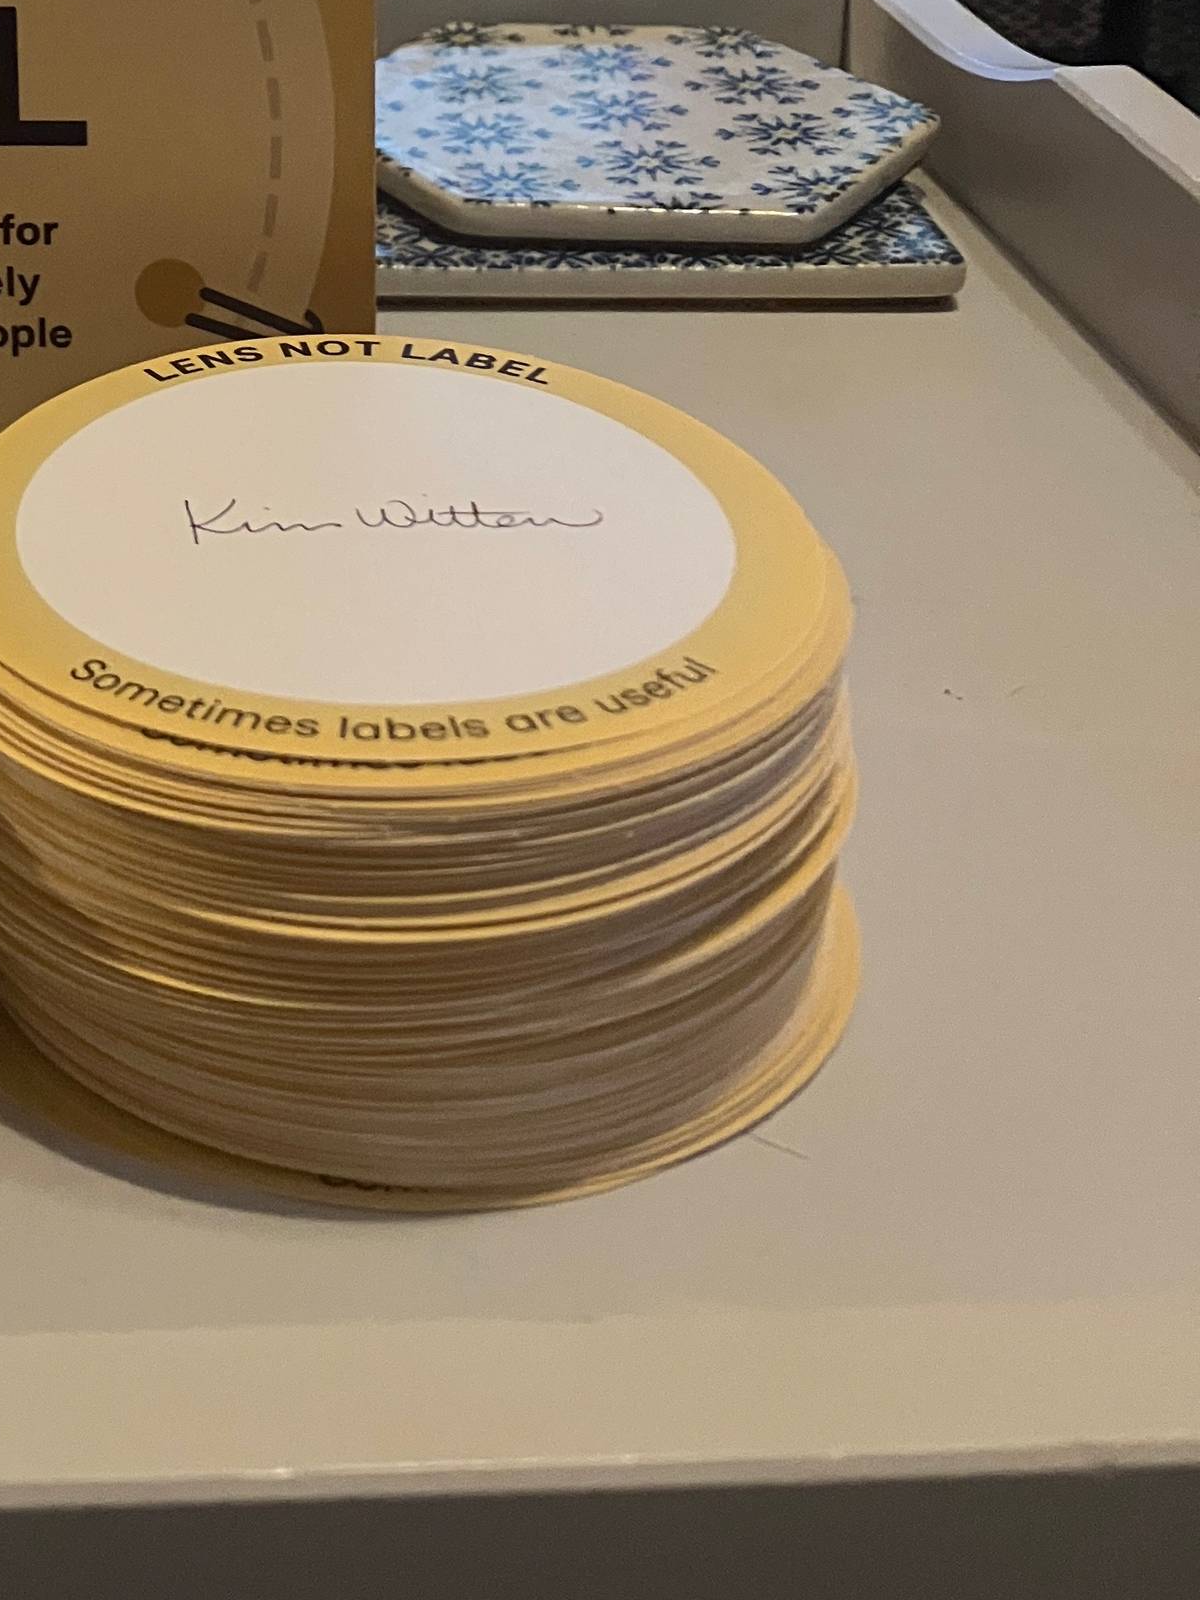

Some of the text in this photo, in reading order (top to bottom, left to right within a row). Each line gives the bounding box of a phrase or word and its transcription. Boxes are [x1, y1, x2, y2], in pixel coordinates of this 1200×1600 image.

[0, 213, 59, 246] for
[143, 340, 549, 385] LENS NOT LABEL
[184, 493, 605, 545] Kim Witten
[69, 656, 719, 742] Sometimes labels are useful
